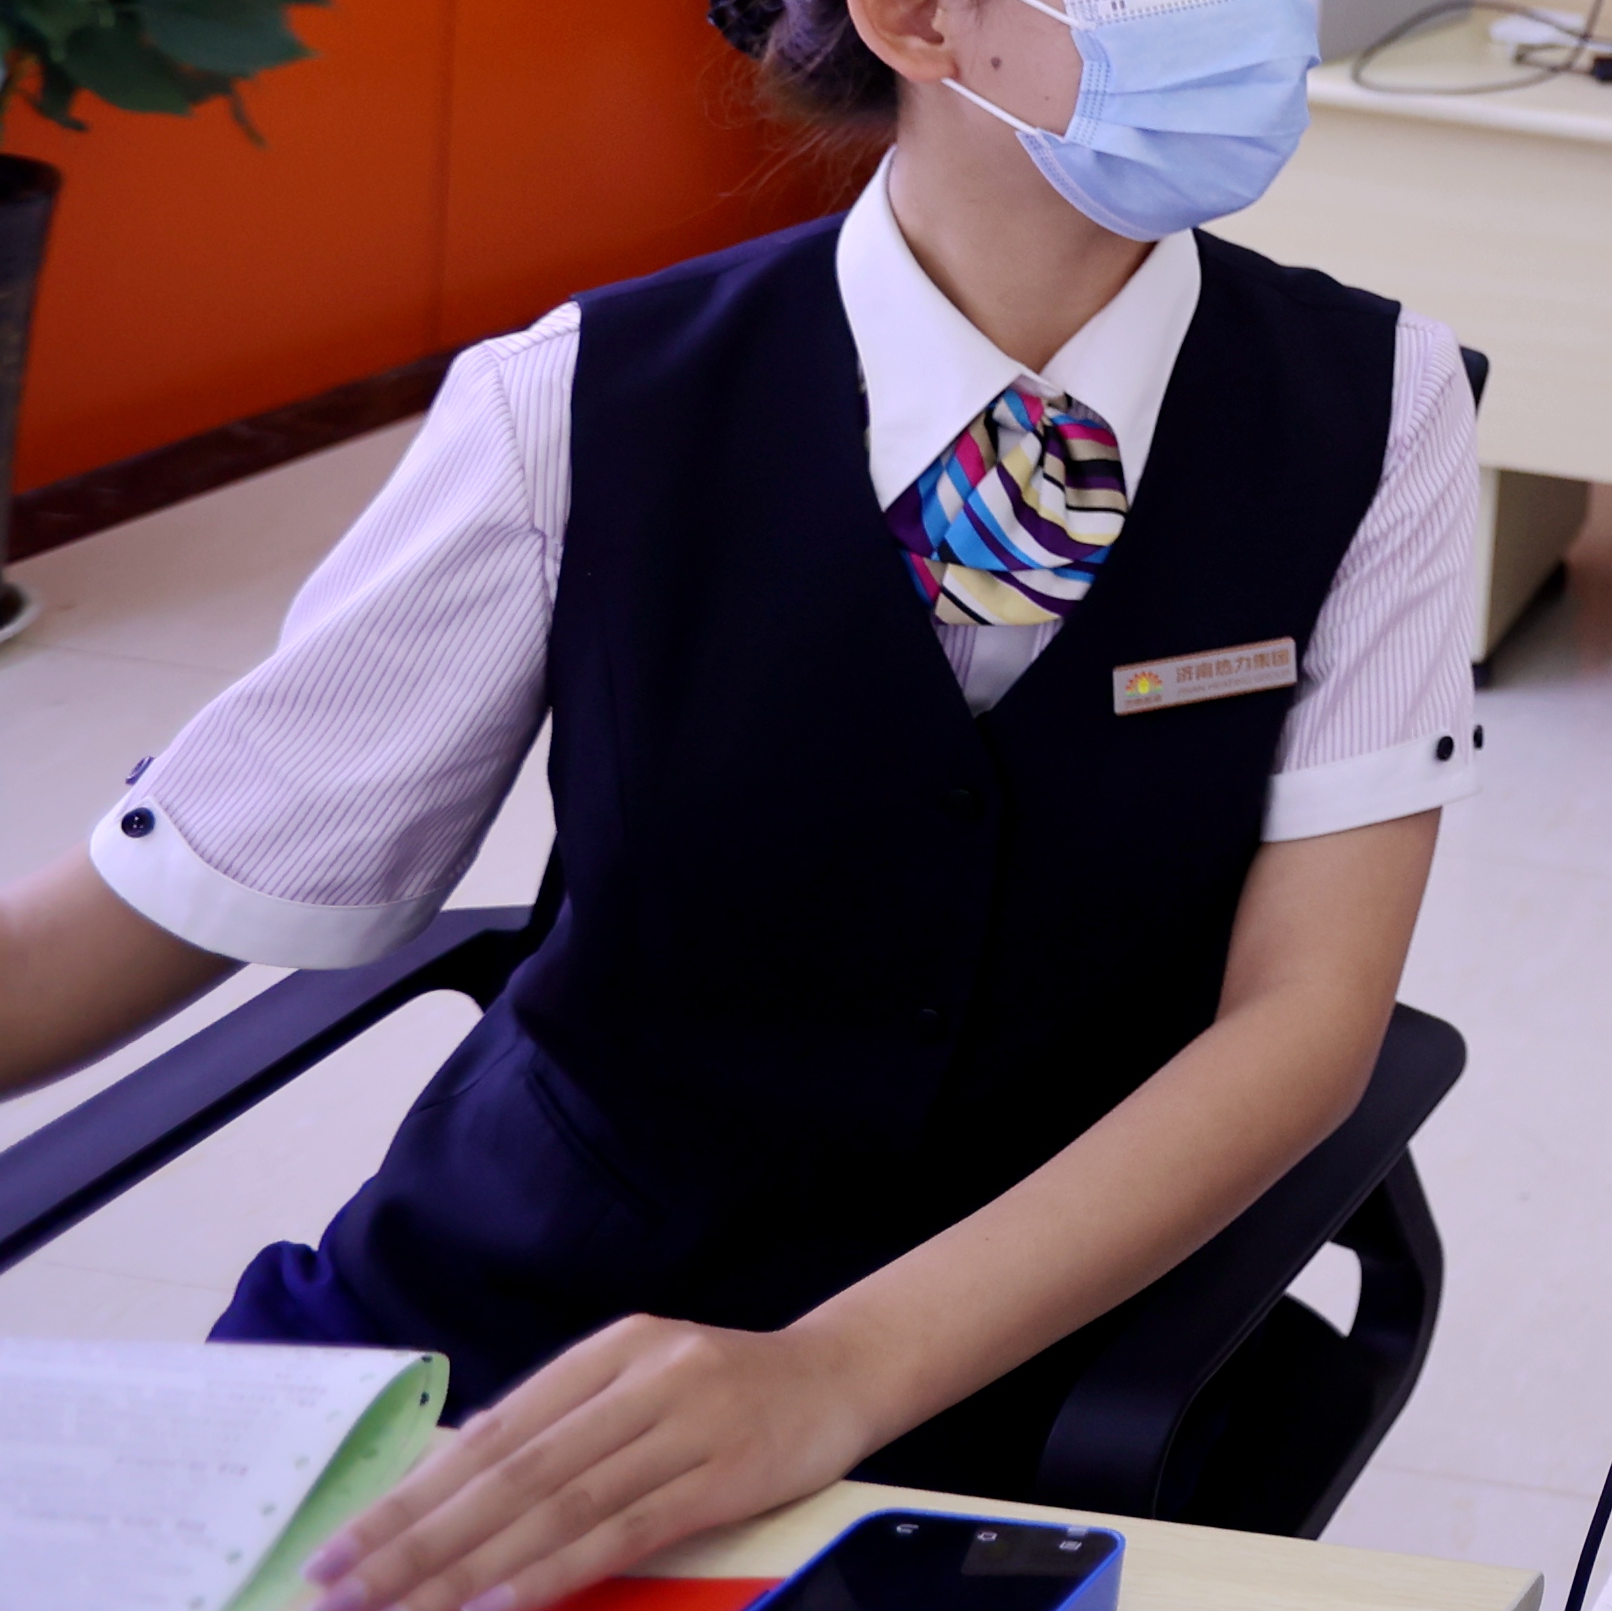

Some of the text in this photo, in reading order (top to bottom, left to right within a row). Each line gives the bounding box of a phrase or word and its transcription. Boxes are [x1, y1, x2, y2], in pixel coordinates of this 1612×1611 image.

[1176, 648, 1290, 683] 济南热力集团
